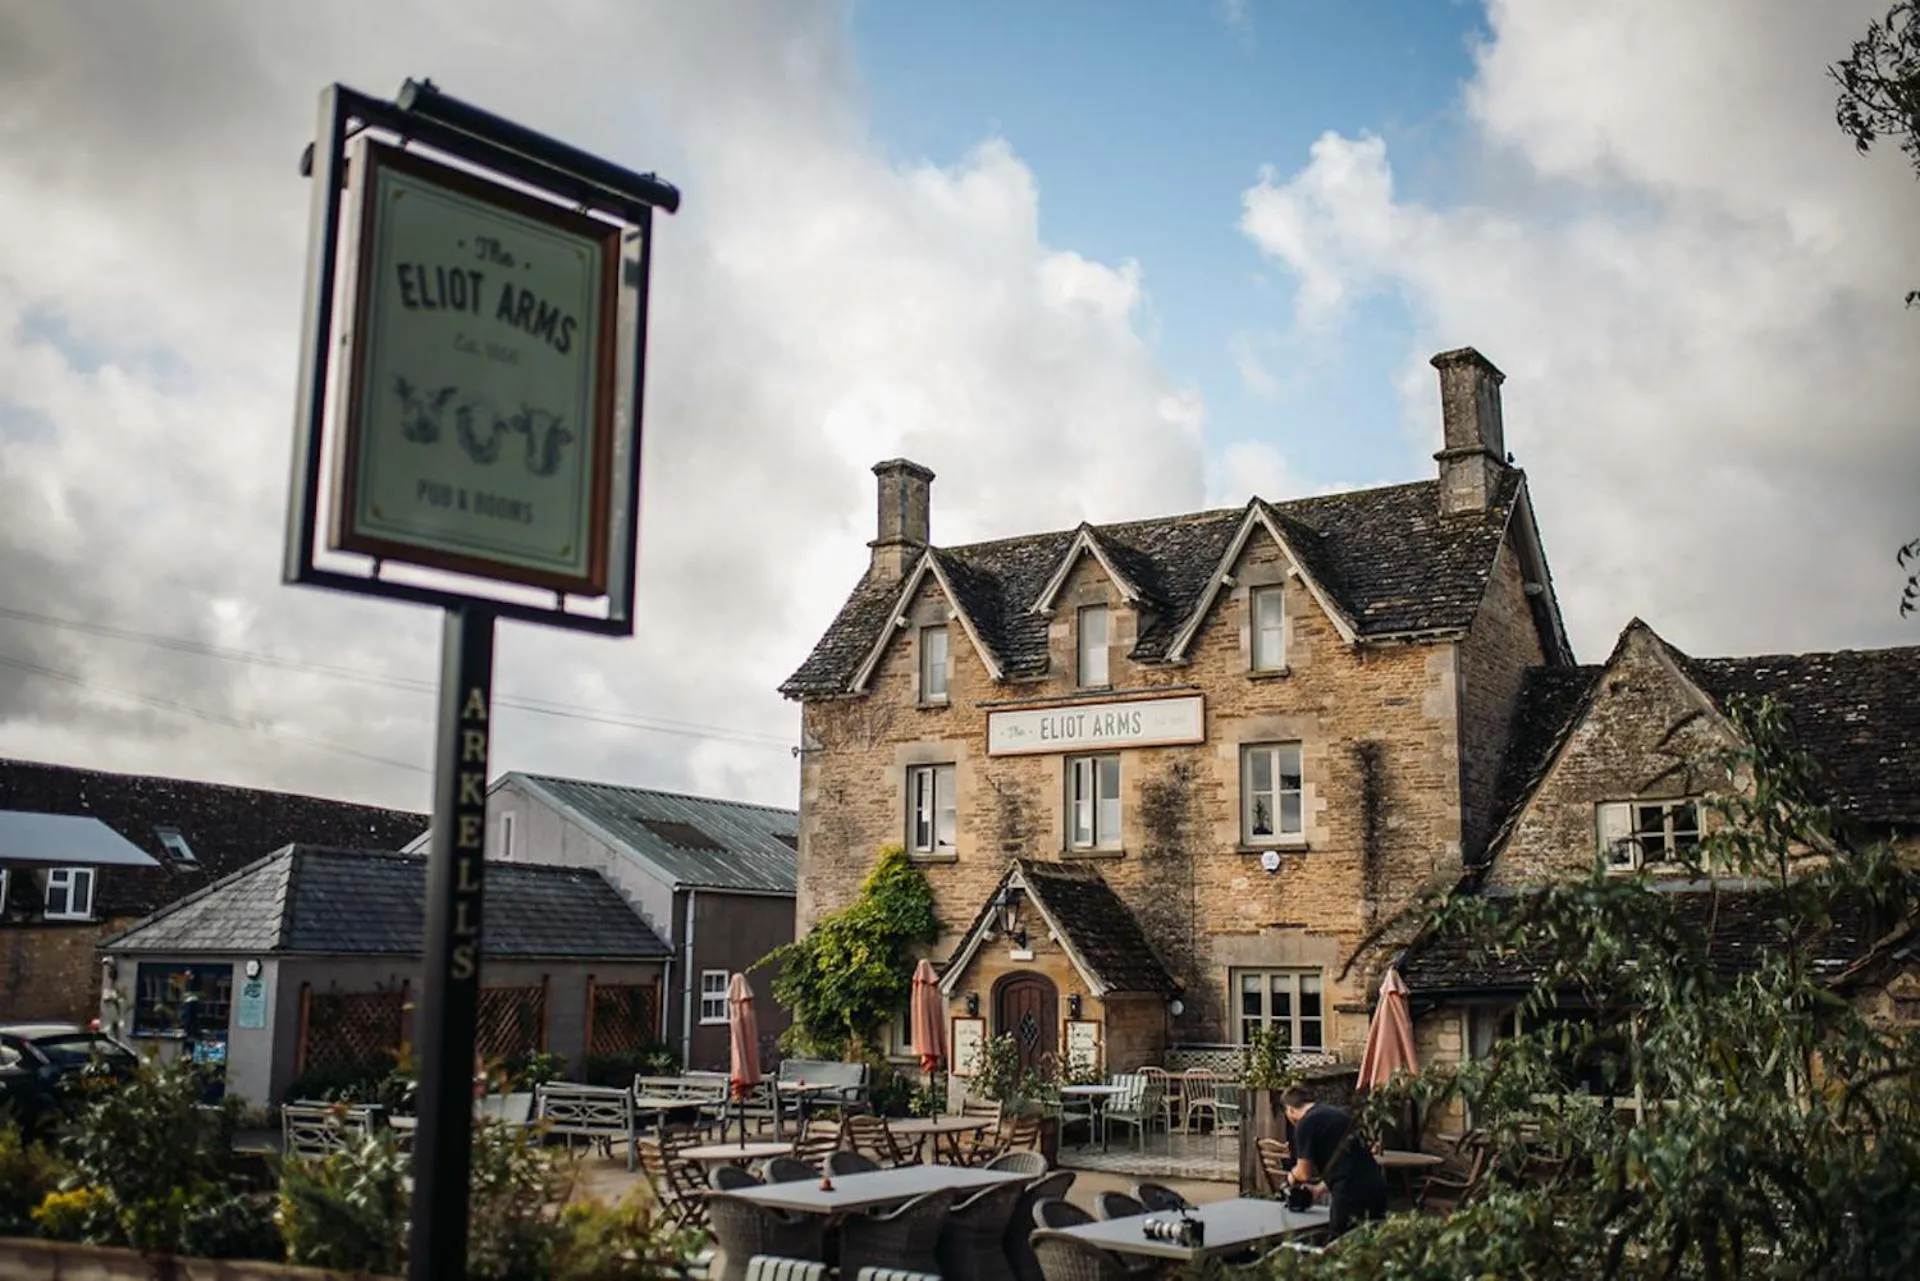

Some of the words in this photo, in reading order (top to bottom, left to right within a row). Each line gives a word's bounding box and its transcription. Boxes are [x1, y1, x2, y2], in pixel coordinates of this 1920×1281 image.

[475, 235, 515, 268] The
[397, 263, 484, 316] ELIOT
[495, 281, 578, 355] ARMS
[1040, 714, 1085, 740] ELIOT
[1092, 711, 1142, 737] ARMS
